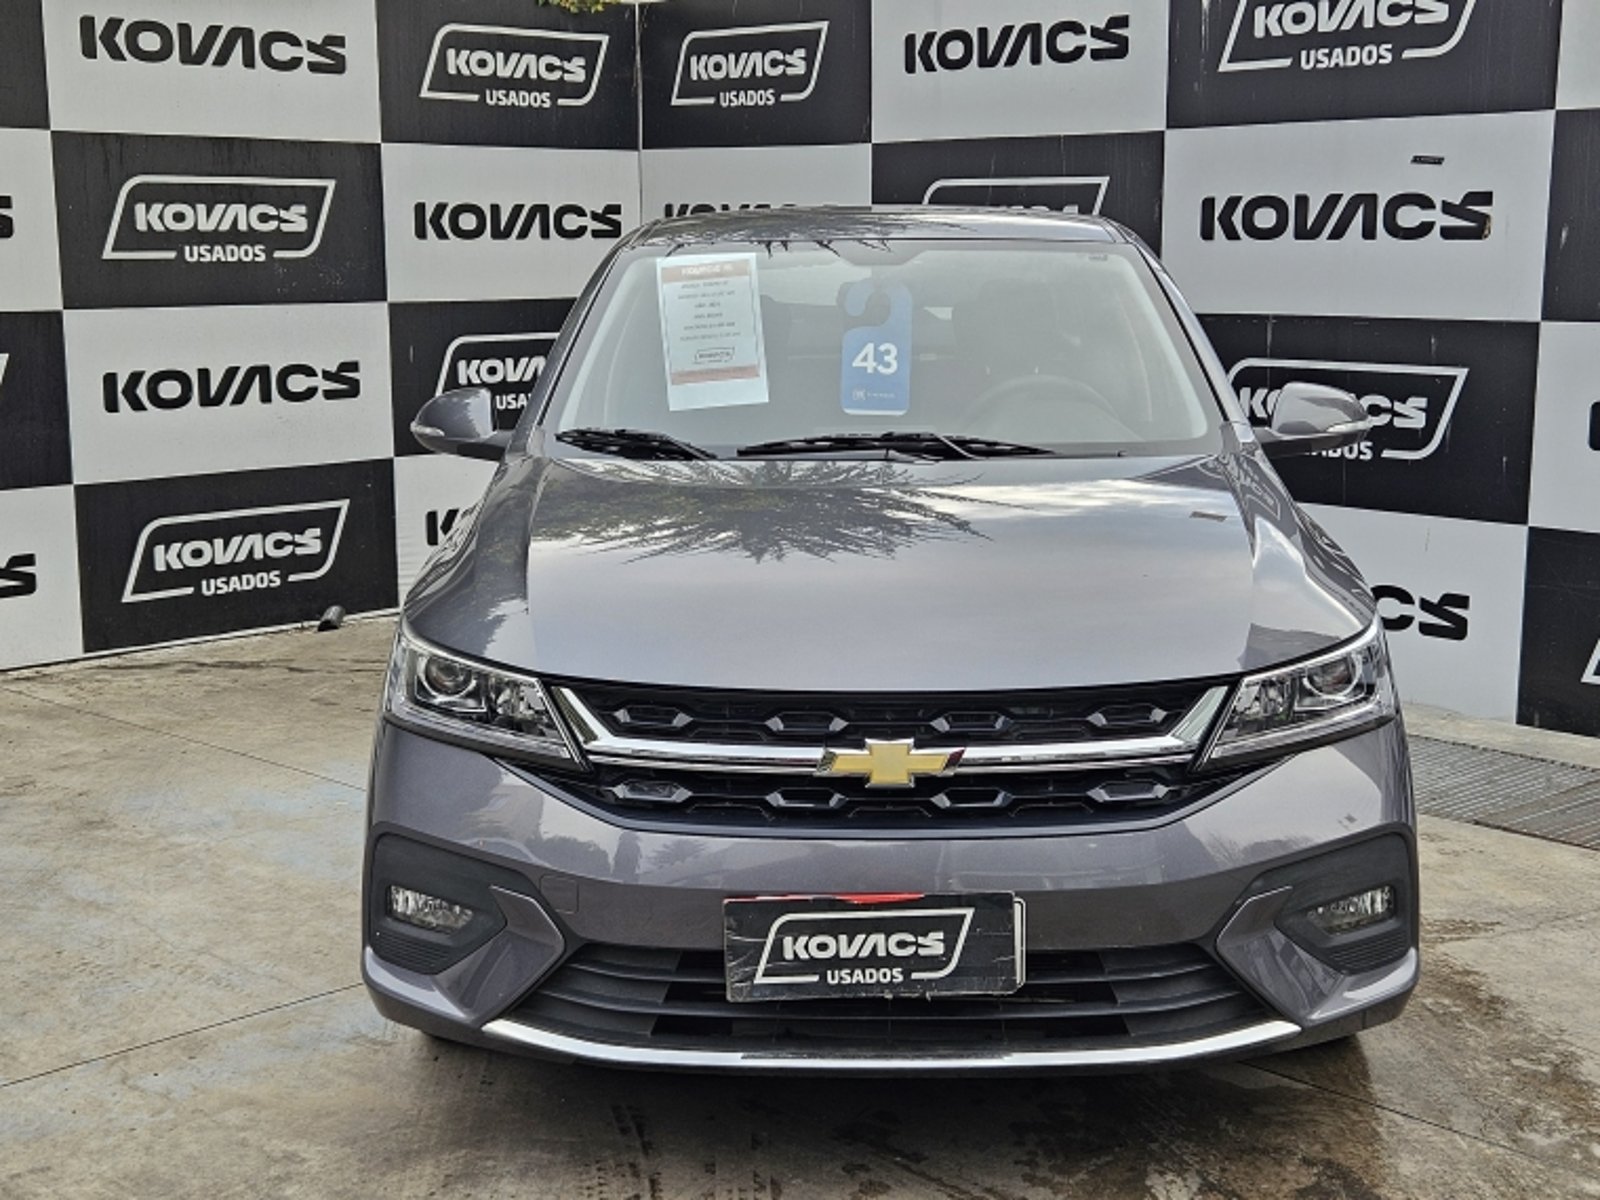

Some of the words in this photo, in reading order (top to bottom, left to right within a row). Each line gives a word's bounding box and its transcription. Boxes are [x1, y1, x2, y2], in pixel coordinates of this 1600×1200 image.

[1253, 0, 1450, 38] KOVACS
[80, 15, 346, 74] KOVACS
[905, 15, 1129, 74] KOVACS
[1300, 43, 1393, 71] USADOS
[446, 48, 586, 83] KOVACS
[690, 48, 807, 81] KOVACS
[485, 89, 552, 108] USADOS
[719, 88, 776, 108] USADOS
[134, 202, 308, 232] KOVACS
[414, 202, 622, 241] KOVACS
[1200, 191, 1493, 241] KOVACS
[184, 244, 266, 263] USADOS
[851, 342, 898, 375] 43
[103, 361, 360, 413] KOVACS
[153, 527, 322, 572] KOVACS
[201, 570, 281, 597] USADOS
[782, 931, 945, 961] KOVACS
[826, 967, 904, 985] USADOS
